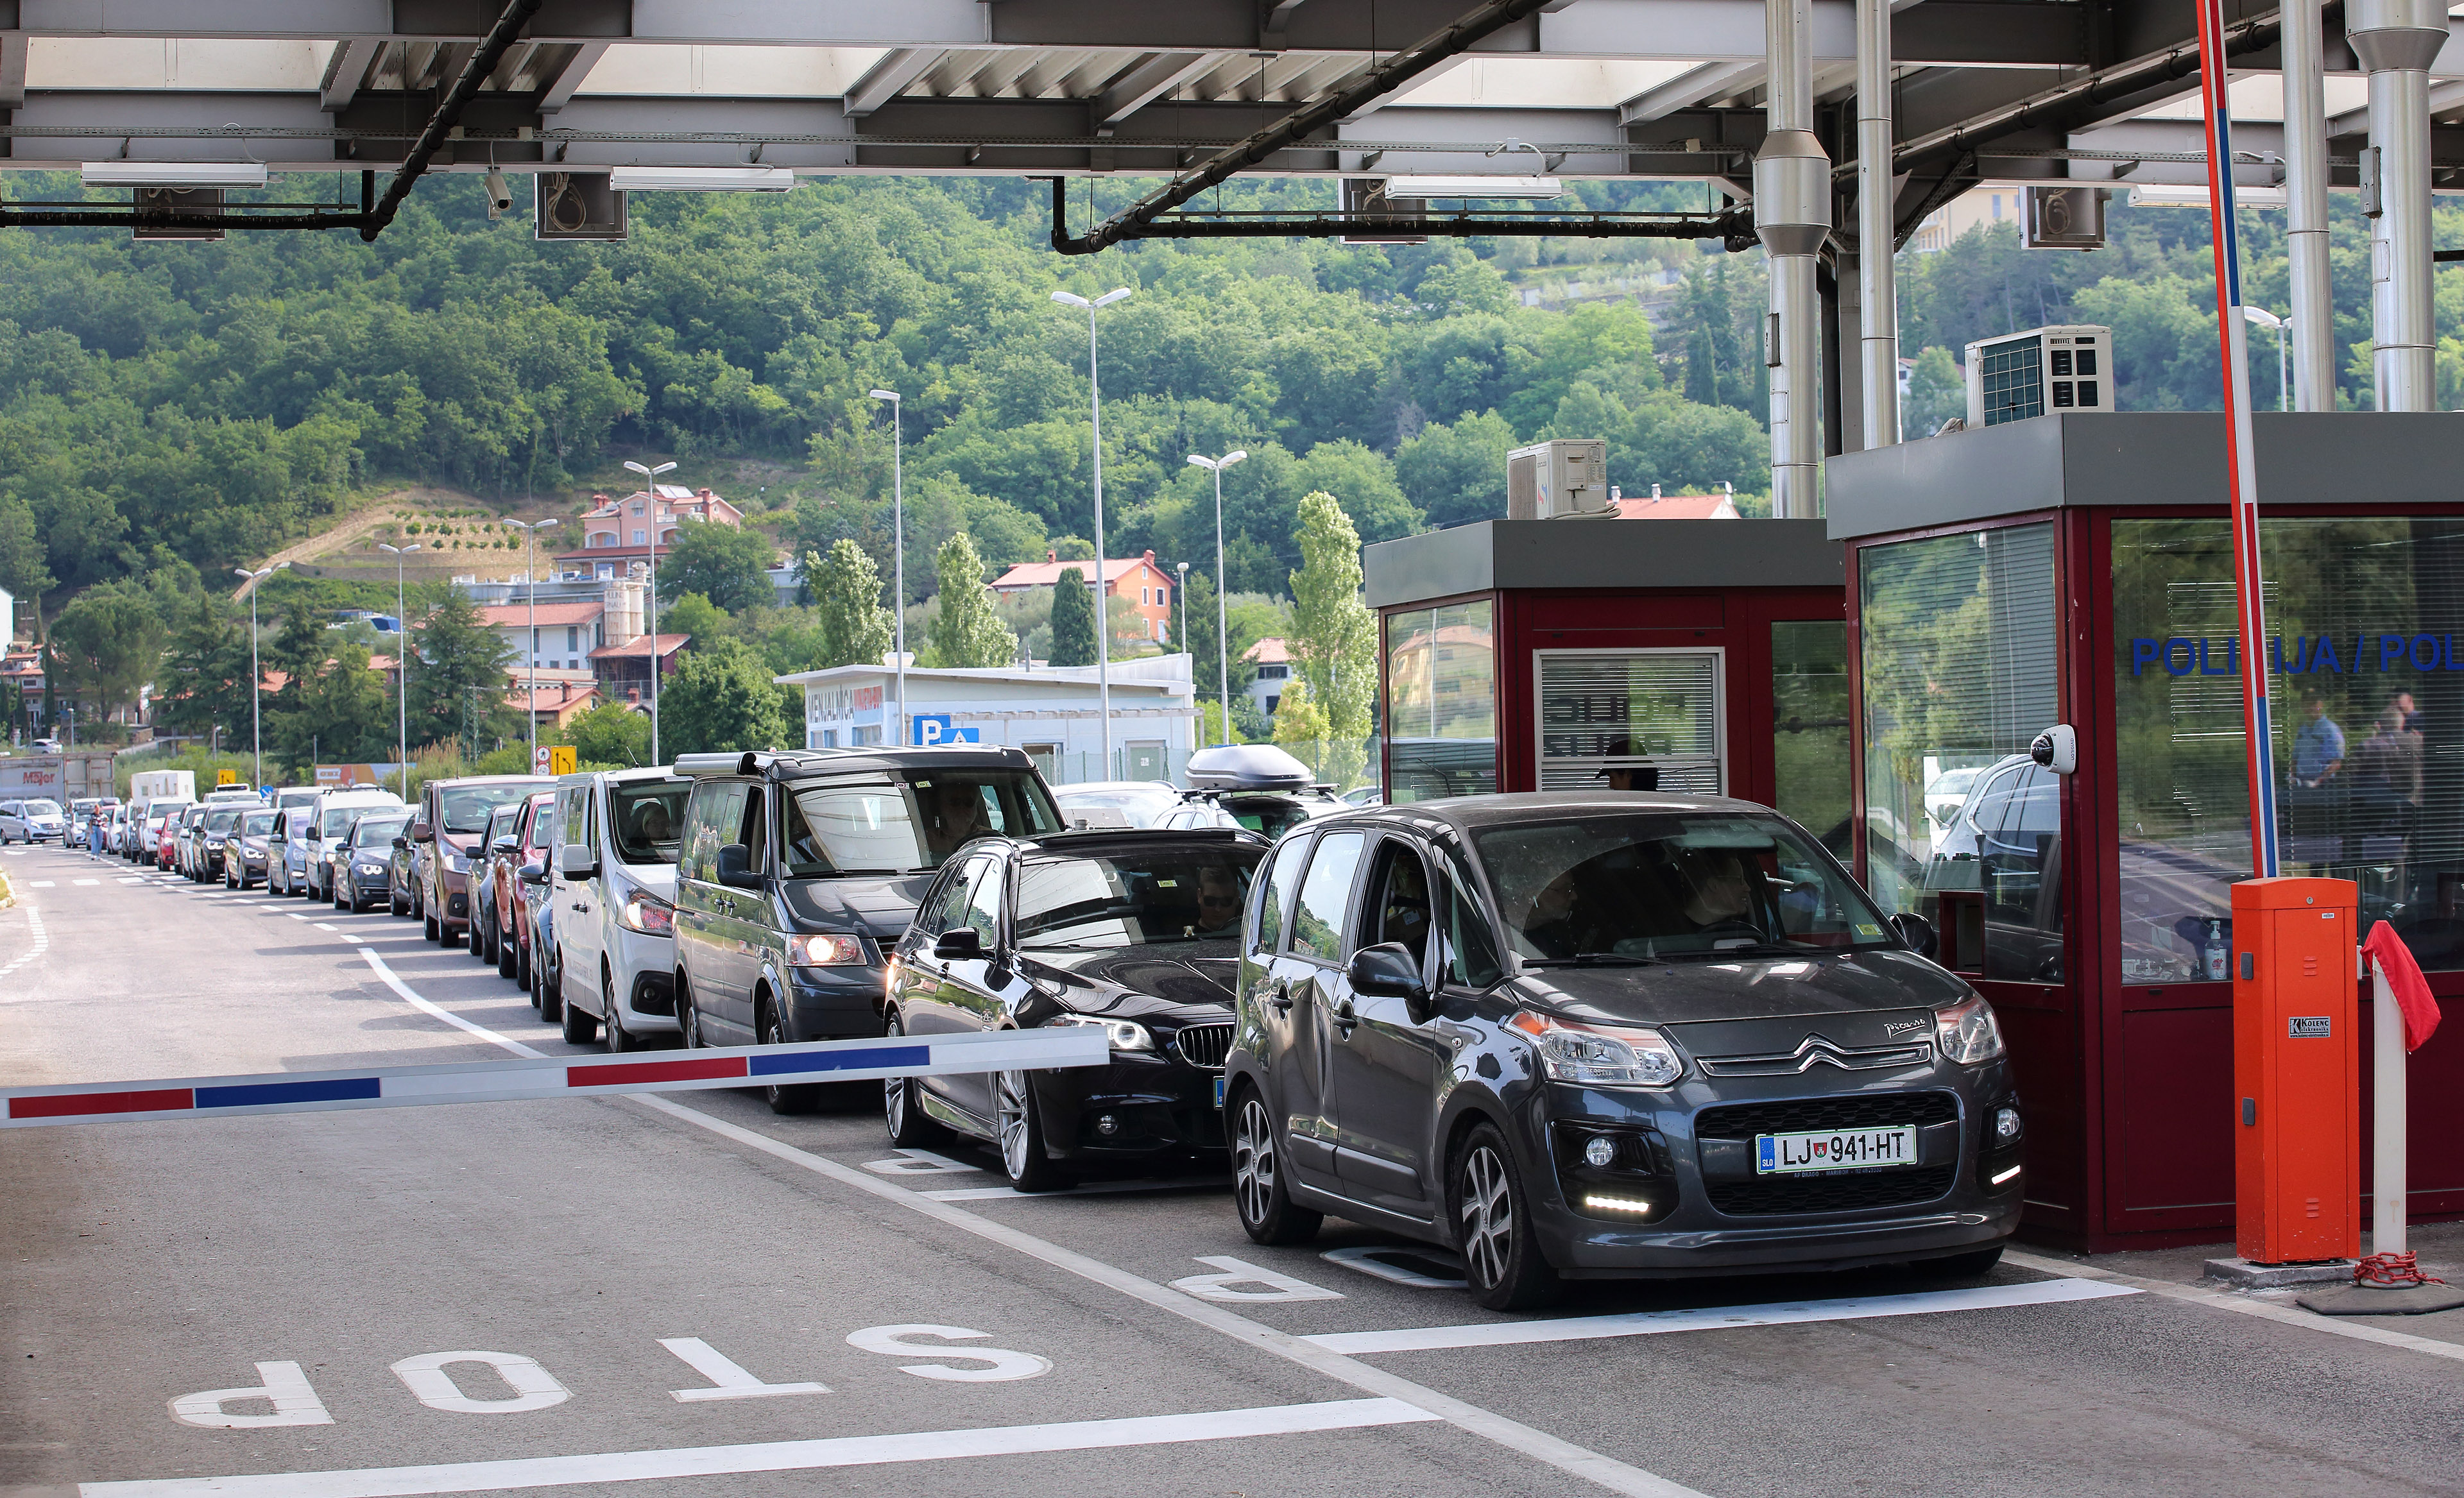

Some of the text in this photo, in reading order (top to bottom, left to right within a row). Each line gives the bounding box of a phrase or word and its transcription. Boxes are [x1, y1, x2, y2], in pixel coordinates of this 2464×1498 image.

[2132, 635, 2342, 677] POLIIJA
[808, 688, 855, 724] MENJALNICA
[922, 720, 942, 745] P
[1762, 1159, 1774, 1167] SLO
[1783, 1132, 1905, 1166] LJ 941-HT
[166, 1323, 1054, 1429] STOP
